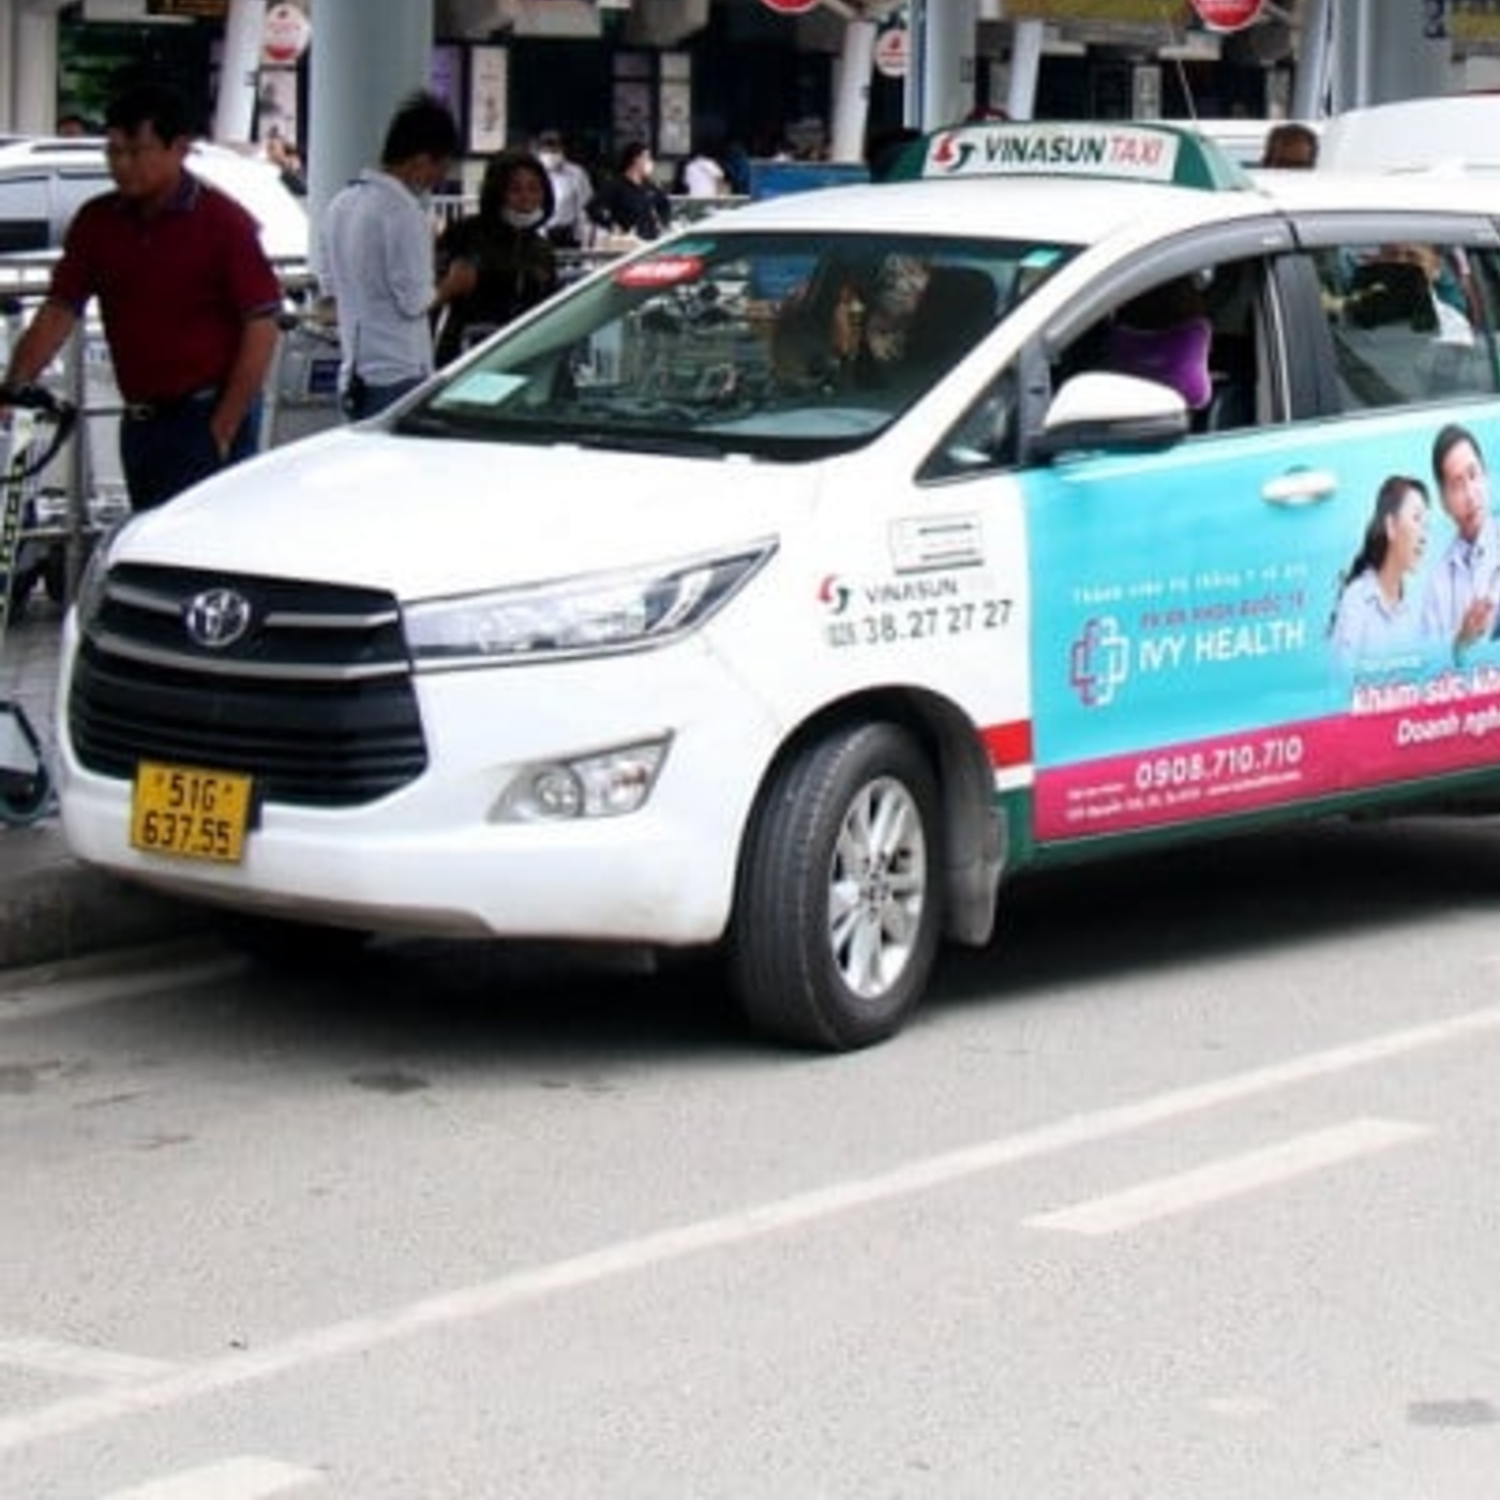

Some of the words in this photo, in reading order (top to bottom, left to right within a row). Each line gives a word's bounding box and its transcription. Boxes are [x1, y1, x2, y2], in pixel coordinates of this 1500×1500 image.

[985, 135, 1108, 164] VINASUN
[1109, 136, 1165, 166] TAXI
[864, 577, 960, 606] VINASUN
[945, 602, 977, 635] 27
[982, 598, 1014, 630] 27
[1139, 635, 1186, 671] IVY
[1195, 619, 1306, 666] HEALTH
[1397, 713, 1460, 746] Doanh
[1135, 735, 1304, 790] 0908.710.710
[168, 772, 218, 812] 51G
[142, 808, 232, 856] 637.55
